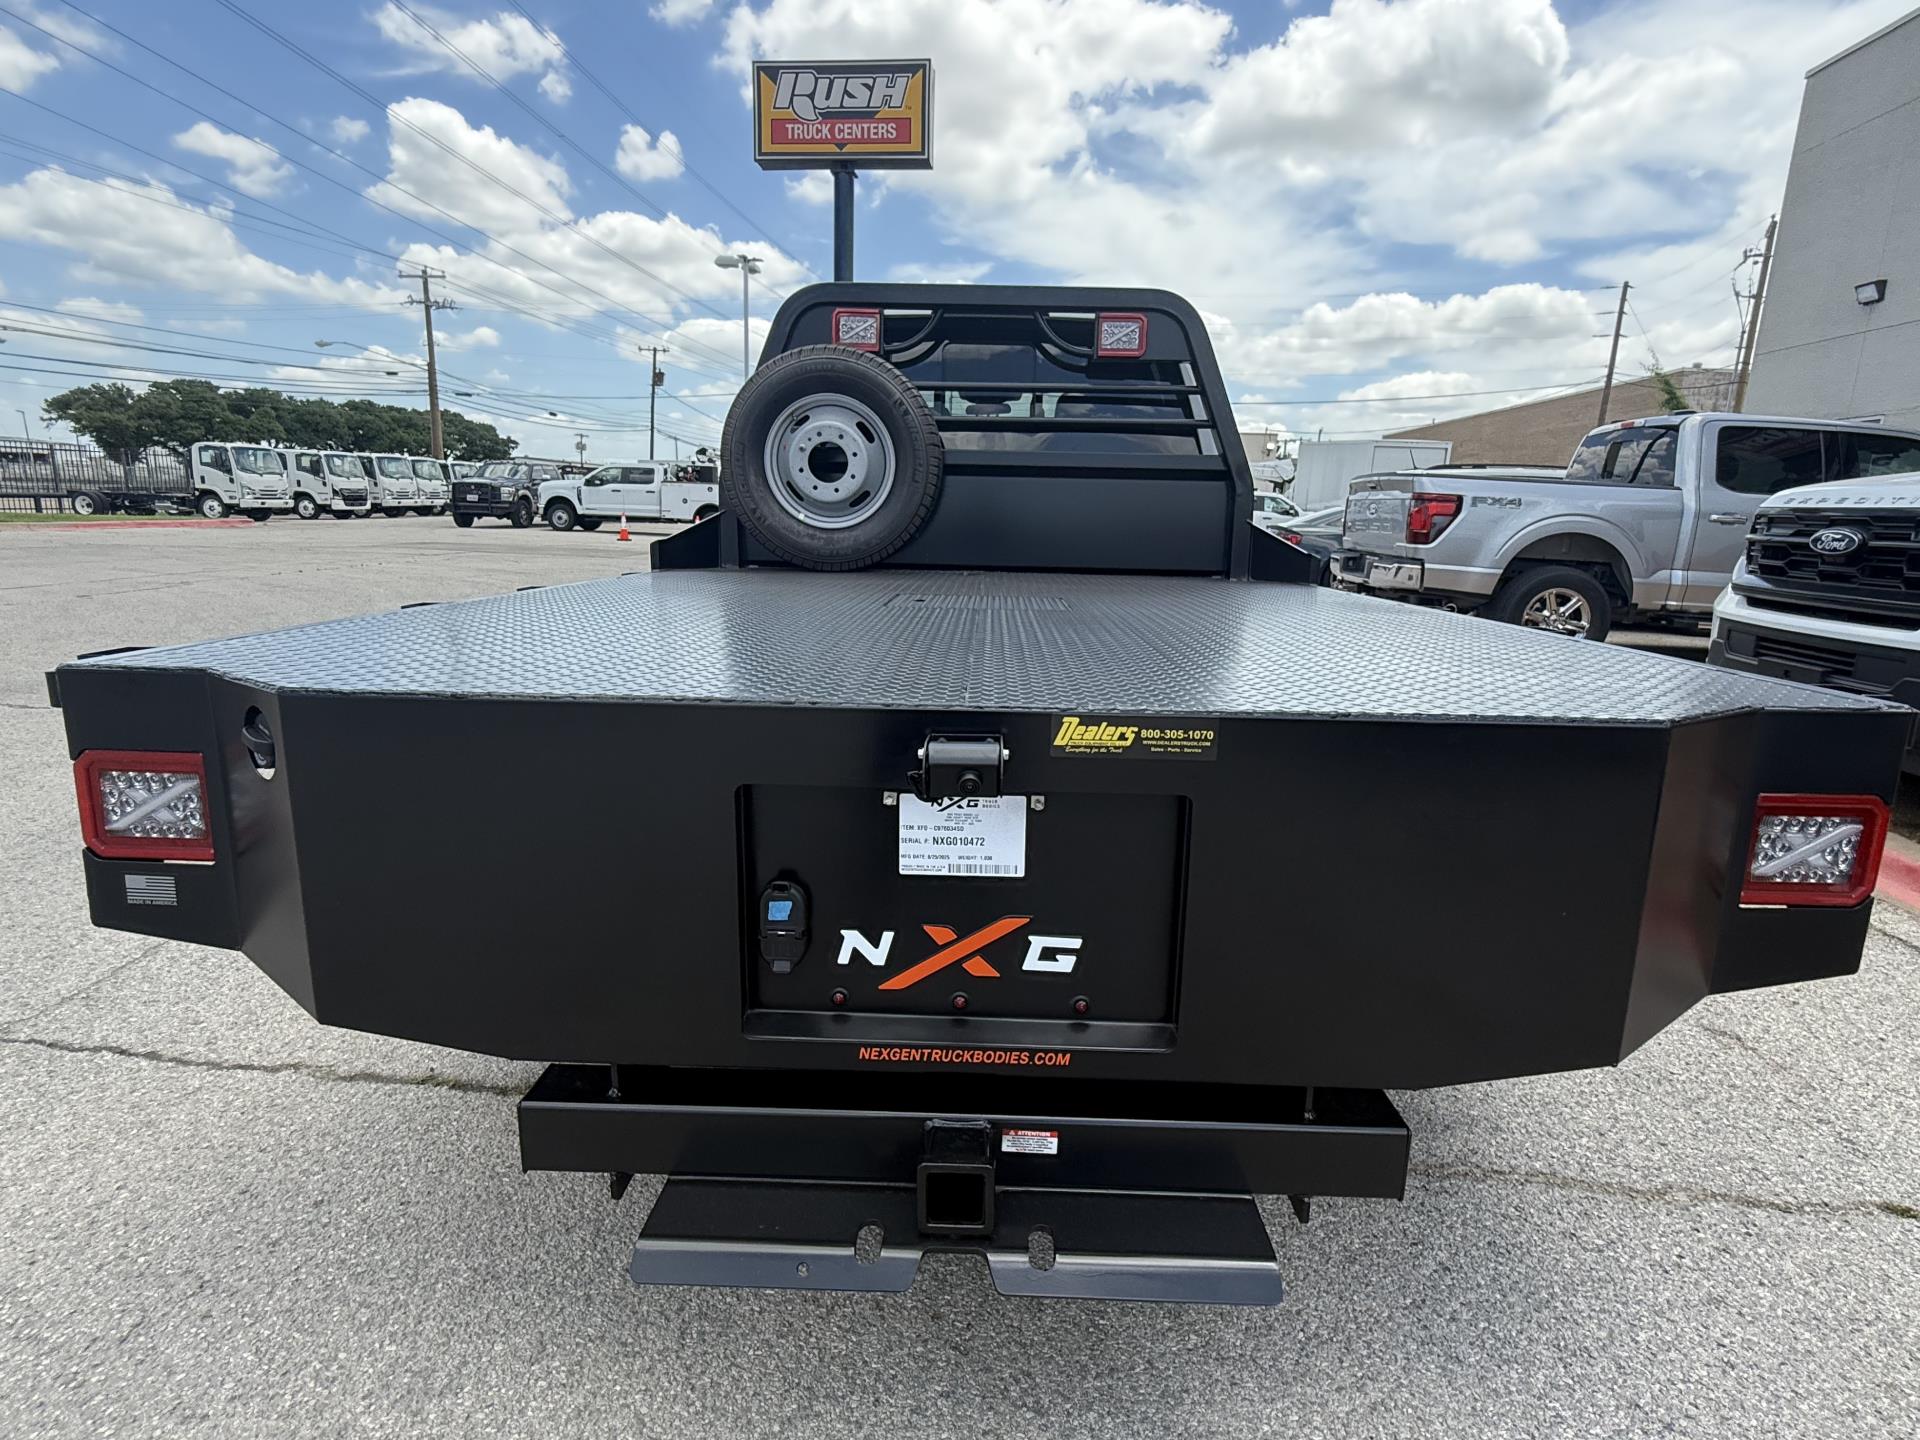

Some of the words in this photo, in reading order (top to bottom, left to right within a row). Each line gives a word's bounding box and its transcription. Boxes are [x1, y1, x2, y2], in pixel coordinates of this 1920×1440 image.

[772, 70, 912, 122] RUSH
[785, 123, 832, 139] TRUCK
[834, 122, 897, 139] CENTERS
[1470, 495, 1522, 509] FX4
[1053, 716, 1139, 747] Dealers
[1140, 729, 1214, 740] 800-305-1070
[1142, 739, 1211, 747] WWW.DEALERSTRUCK.COM
[932, 836, 985, 847] NXG010472
[837, 915, 1083, 990] NXG
[859, 1046, 1071, 1066] NEXGENTRUCKBODIES.COM
